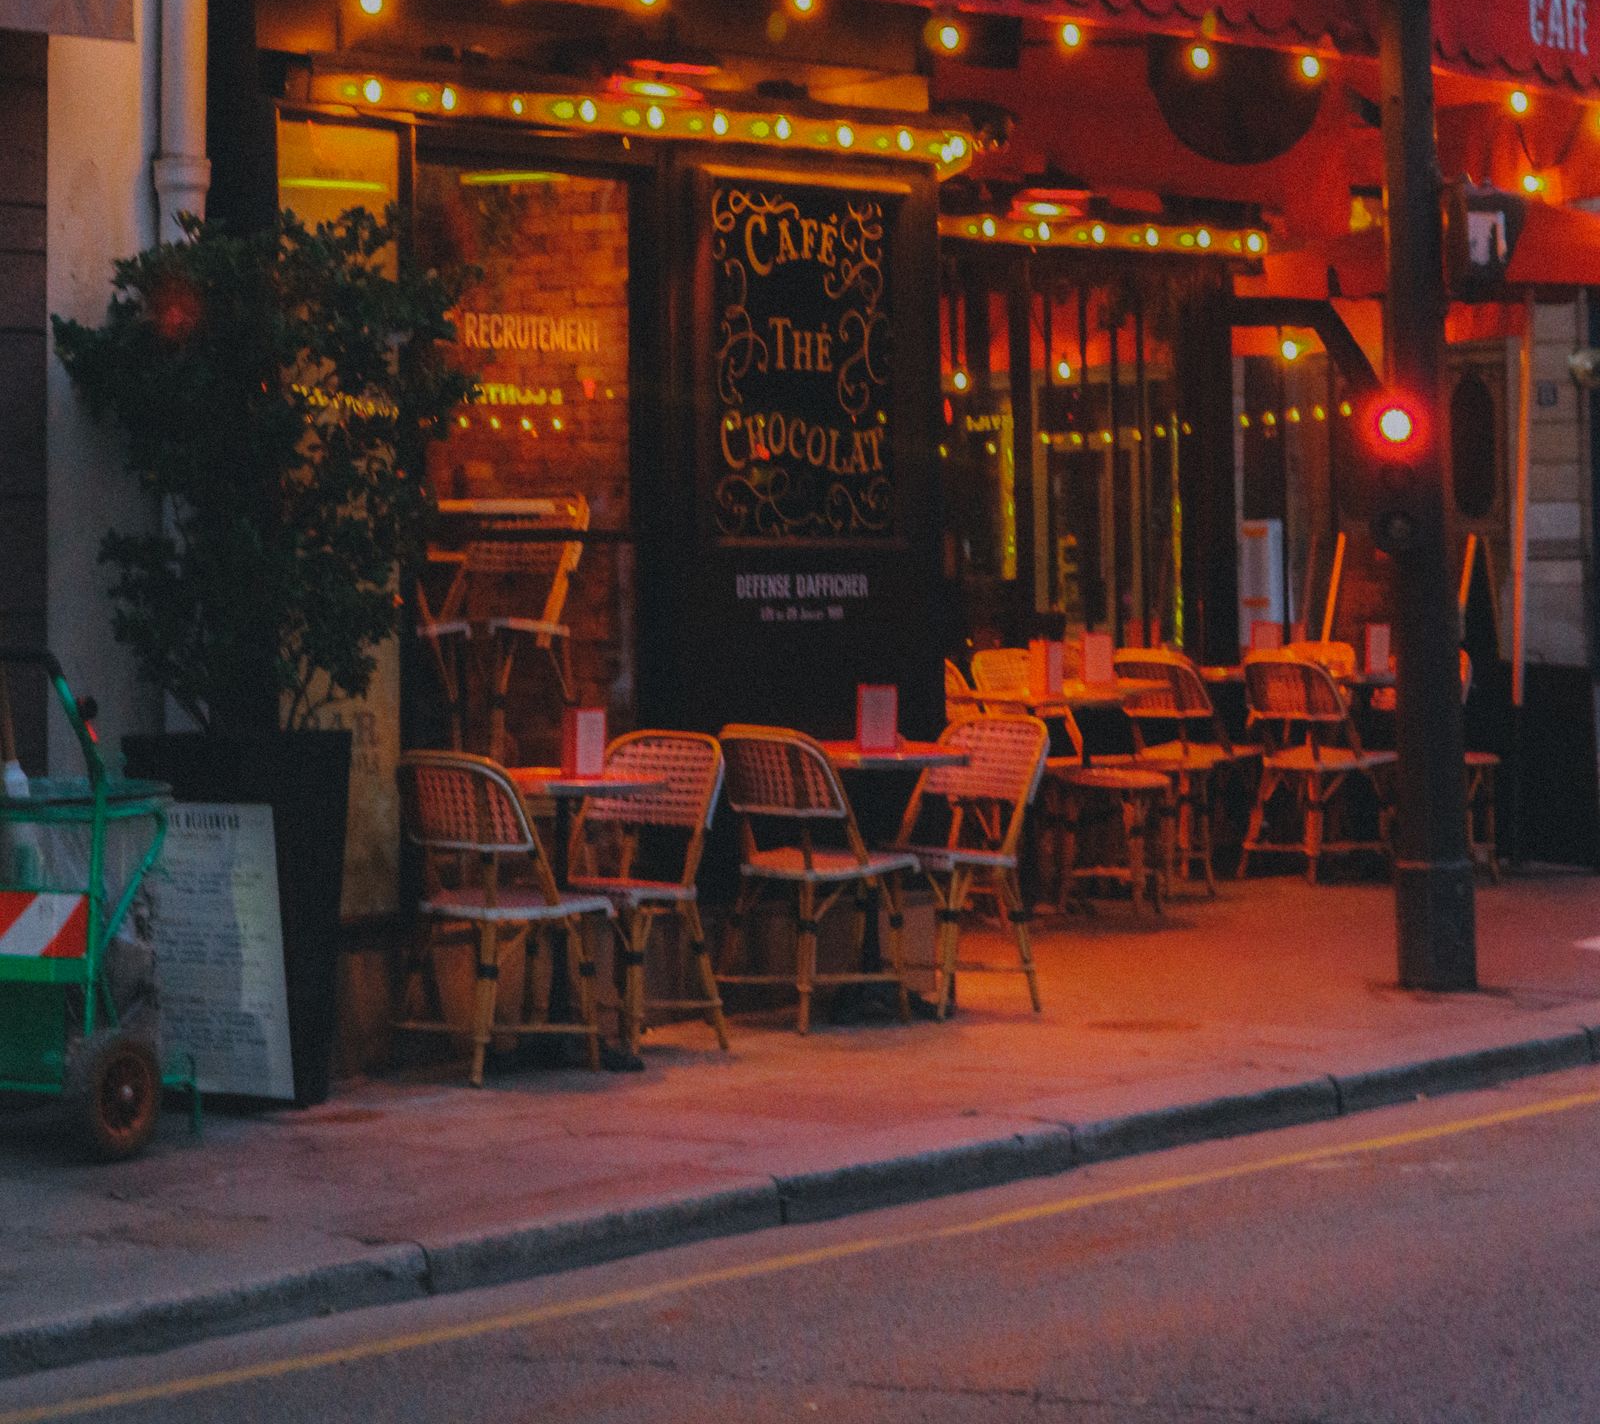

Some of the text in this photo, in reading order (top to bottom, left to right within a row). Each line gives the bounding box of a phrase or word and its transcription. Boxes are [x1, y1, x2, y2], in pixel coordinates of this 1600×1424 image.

[744, 213, 840, 276] CAFÉ
[464, 310, 600, 353] RECRUTEMENT
[768, 315, 834, 373] THÉ
[720, 409, 886, 475] CHOCOLAT
